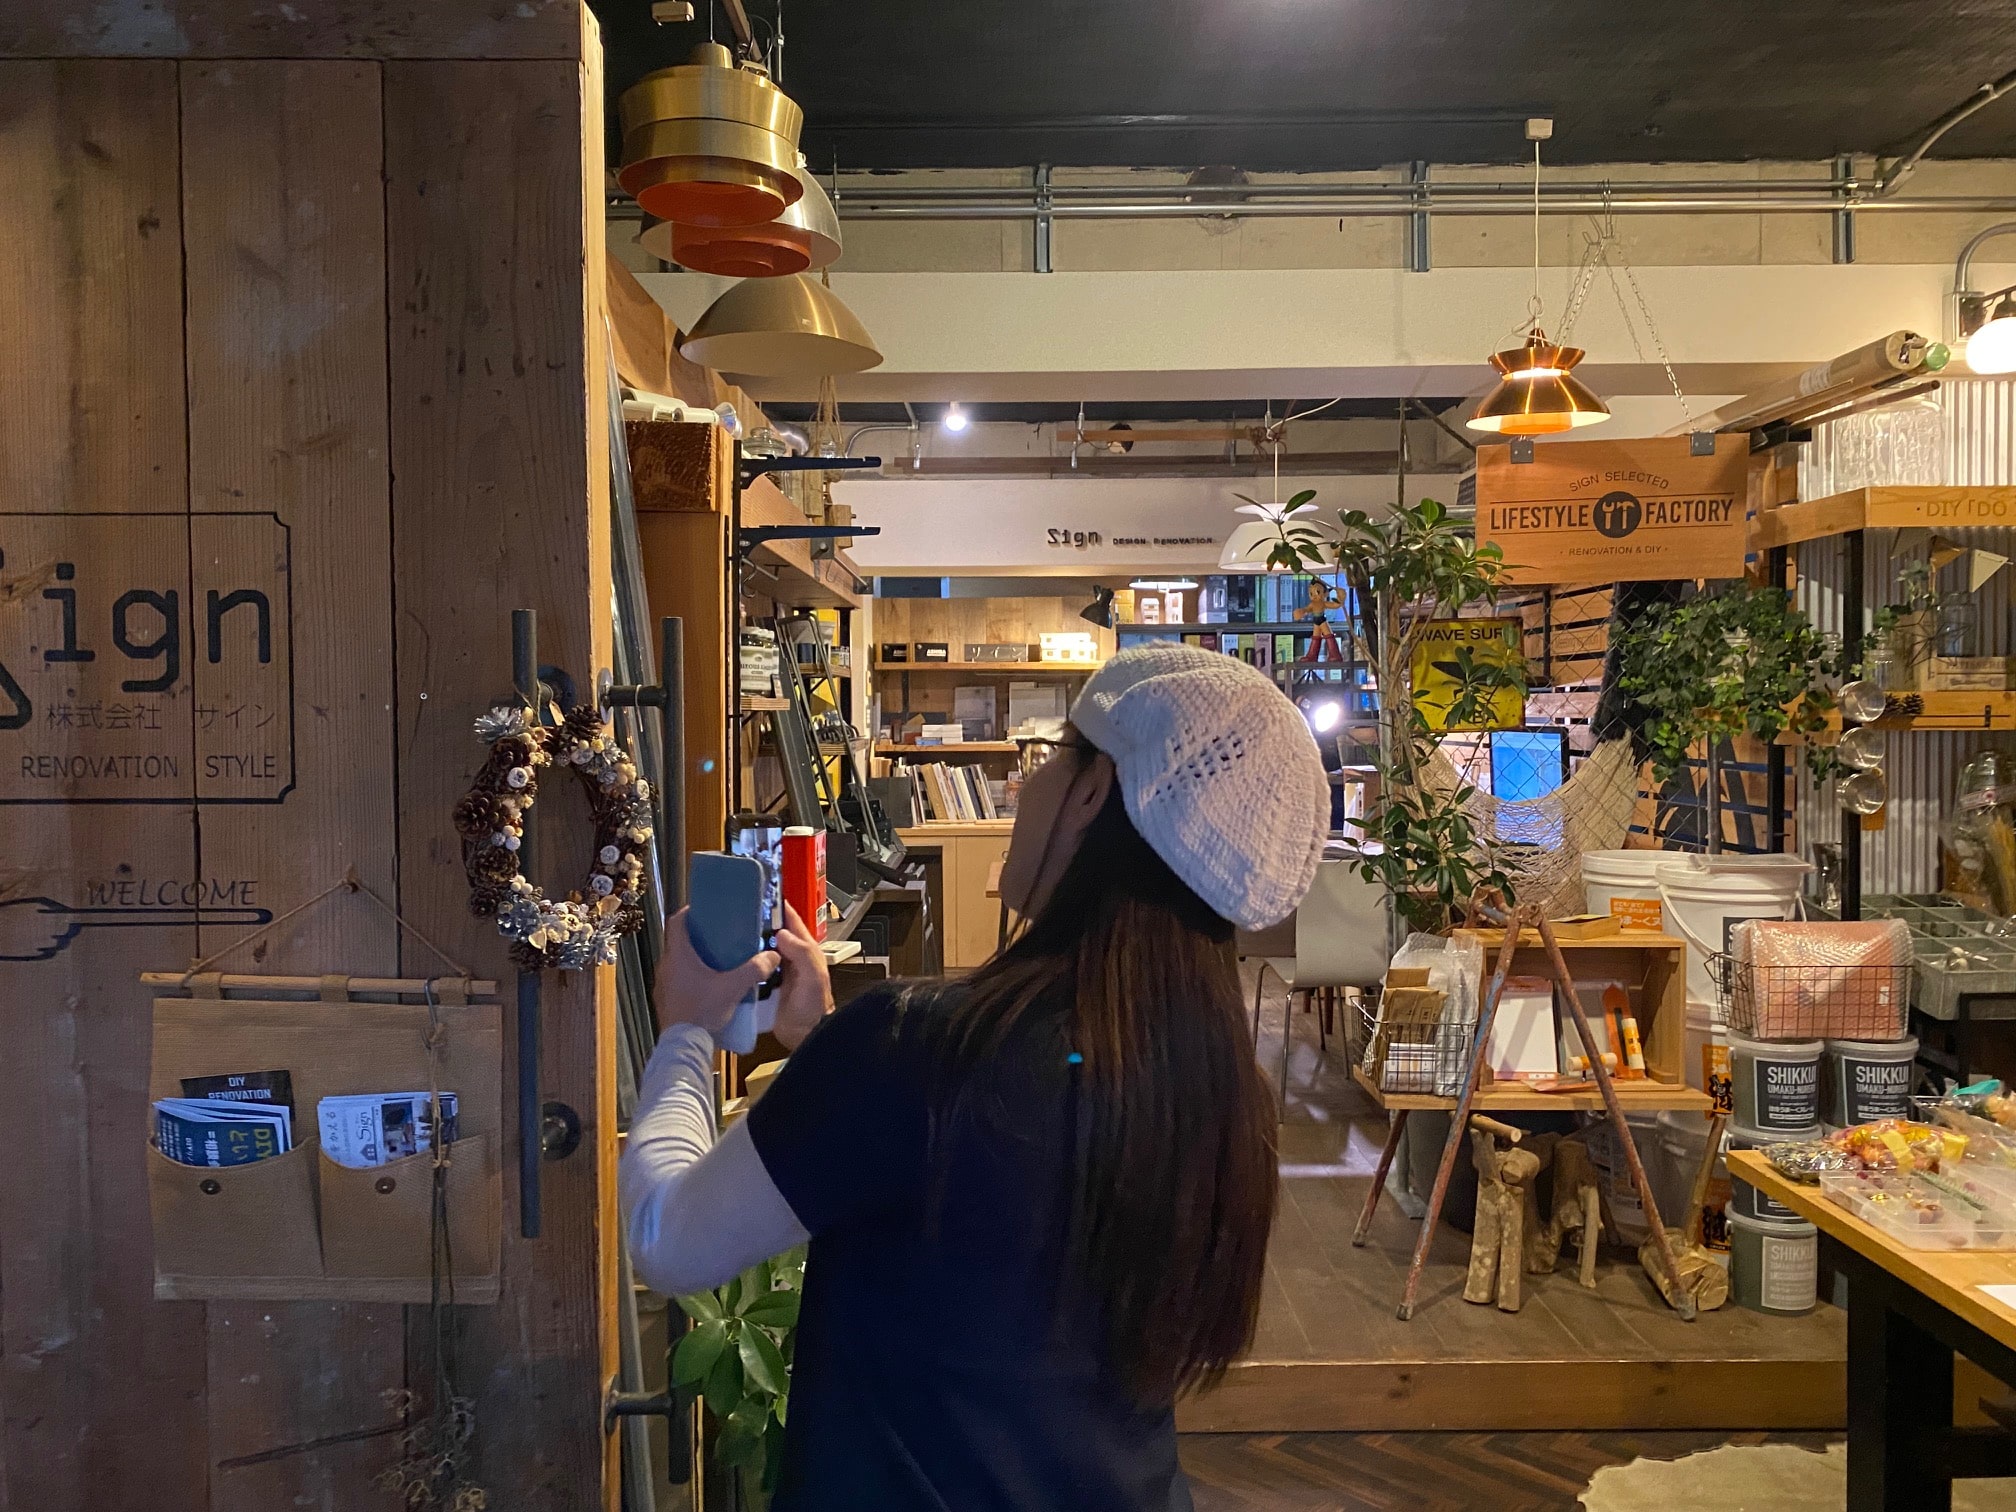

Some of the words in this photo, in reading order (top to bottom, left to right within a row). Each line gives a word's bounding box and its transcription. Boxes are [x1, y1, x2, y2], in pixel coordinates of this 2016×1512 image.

[1569, 474, 1600, 493] SIGN
[1605, 470, 1670, 490] SELECTED
[1490, 504, 1590, 531] LIFESTYLE
[1645, 498, 1734, 525] FACTORY
[1926, 500, 1961, 517] DIY
[1047, 528, 1099, 547] Sign
[1112, 537, 1146, 545] DESIGN
[1568, 544, 1633, 556] RENOVATION
[1644, 545, 1662, 554] DIY
[1417, 628, 1465, 642] WAVE
[46, 703, 163, 731] 株式会社
[195, 703, 276, 731] サイン
[20, 755, 180, 779] RENOVATION
[204, 755, 277, 779] STYLE
[86, 879, 259, 907] WELCOME
[228, 1076, 246, 1087] DIY
[1767, 1065, 1817, 1084] SHIKKUI
[1855, 1065, 1909, 1084] SHIKKUI
[208, 1089, 272, 1101] RENOVATION
